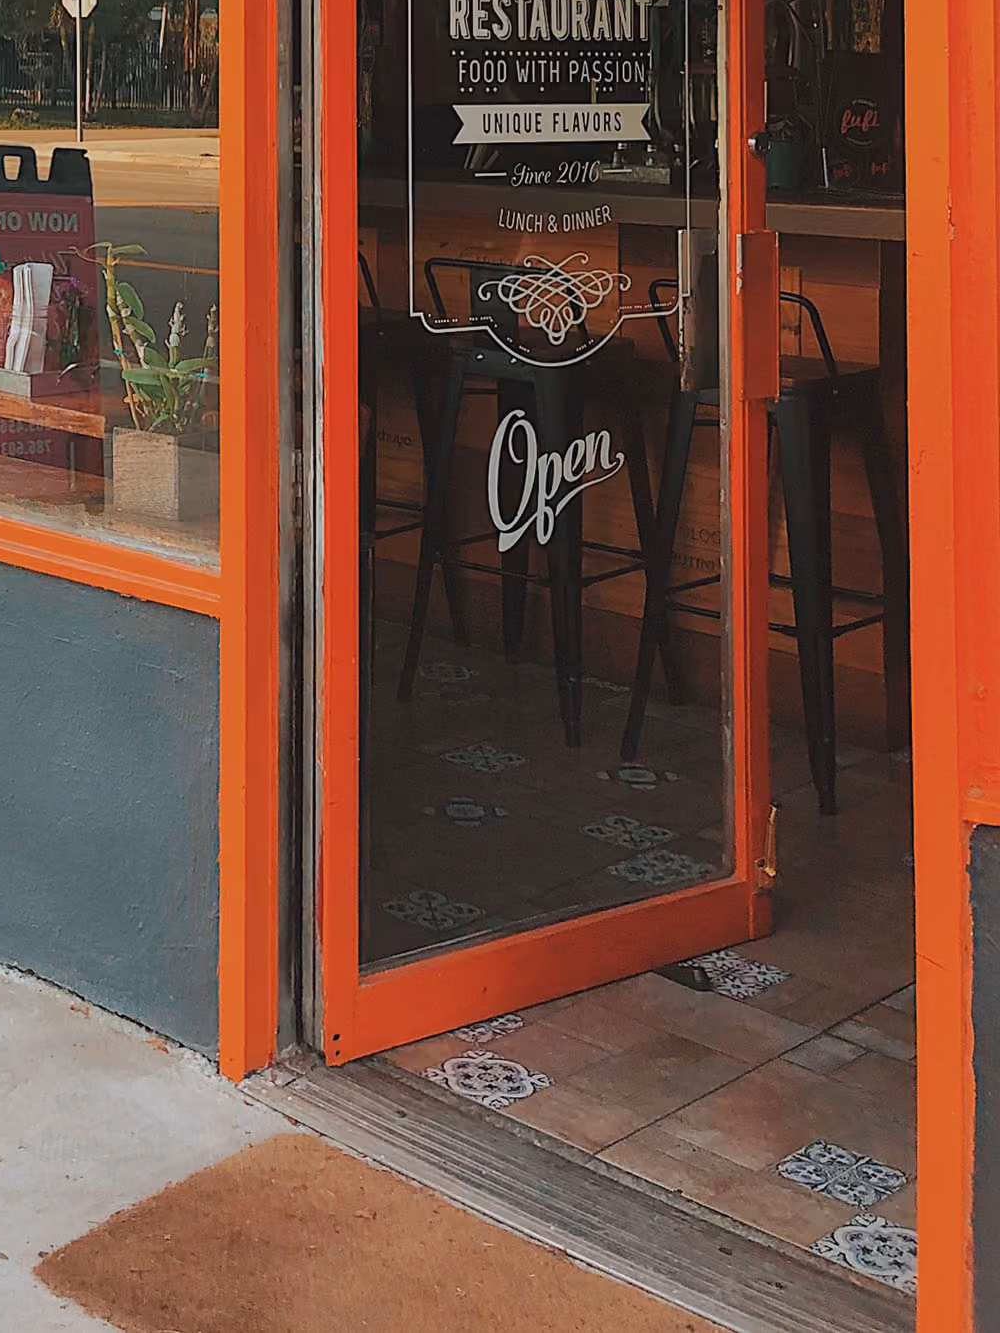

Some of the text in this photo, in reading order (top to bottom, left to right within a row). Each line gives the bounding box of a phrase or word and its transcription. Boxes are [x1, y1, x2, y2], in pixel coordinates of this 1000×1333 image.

[459, 59, 645, 83] FOOD WITH PASSION
[483, 111, 622, 134] UNIQUE FLAVORS
[510, 161, 600, 187] Since 2016
[498, 204, 612, 233] LUNCH & DINNER
[488, 409, 625, 552] Open
